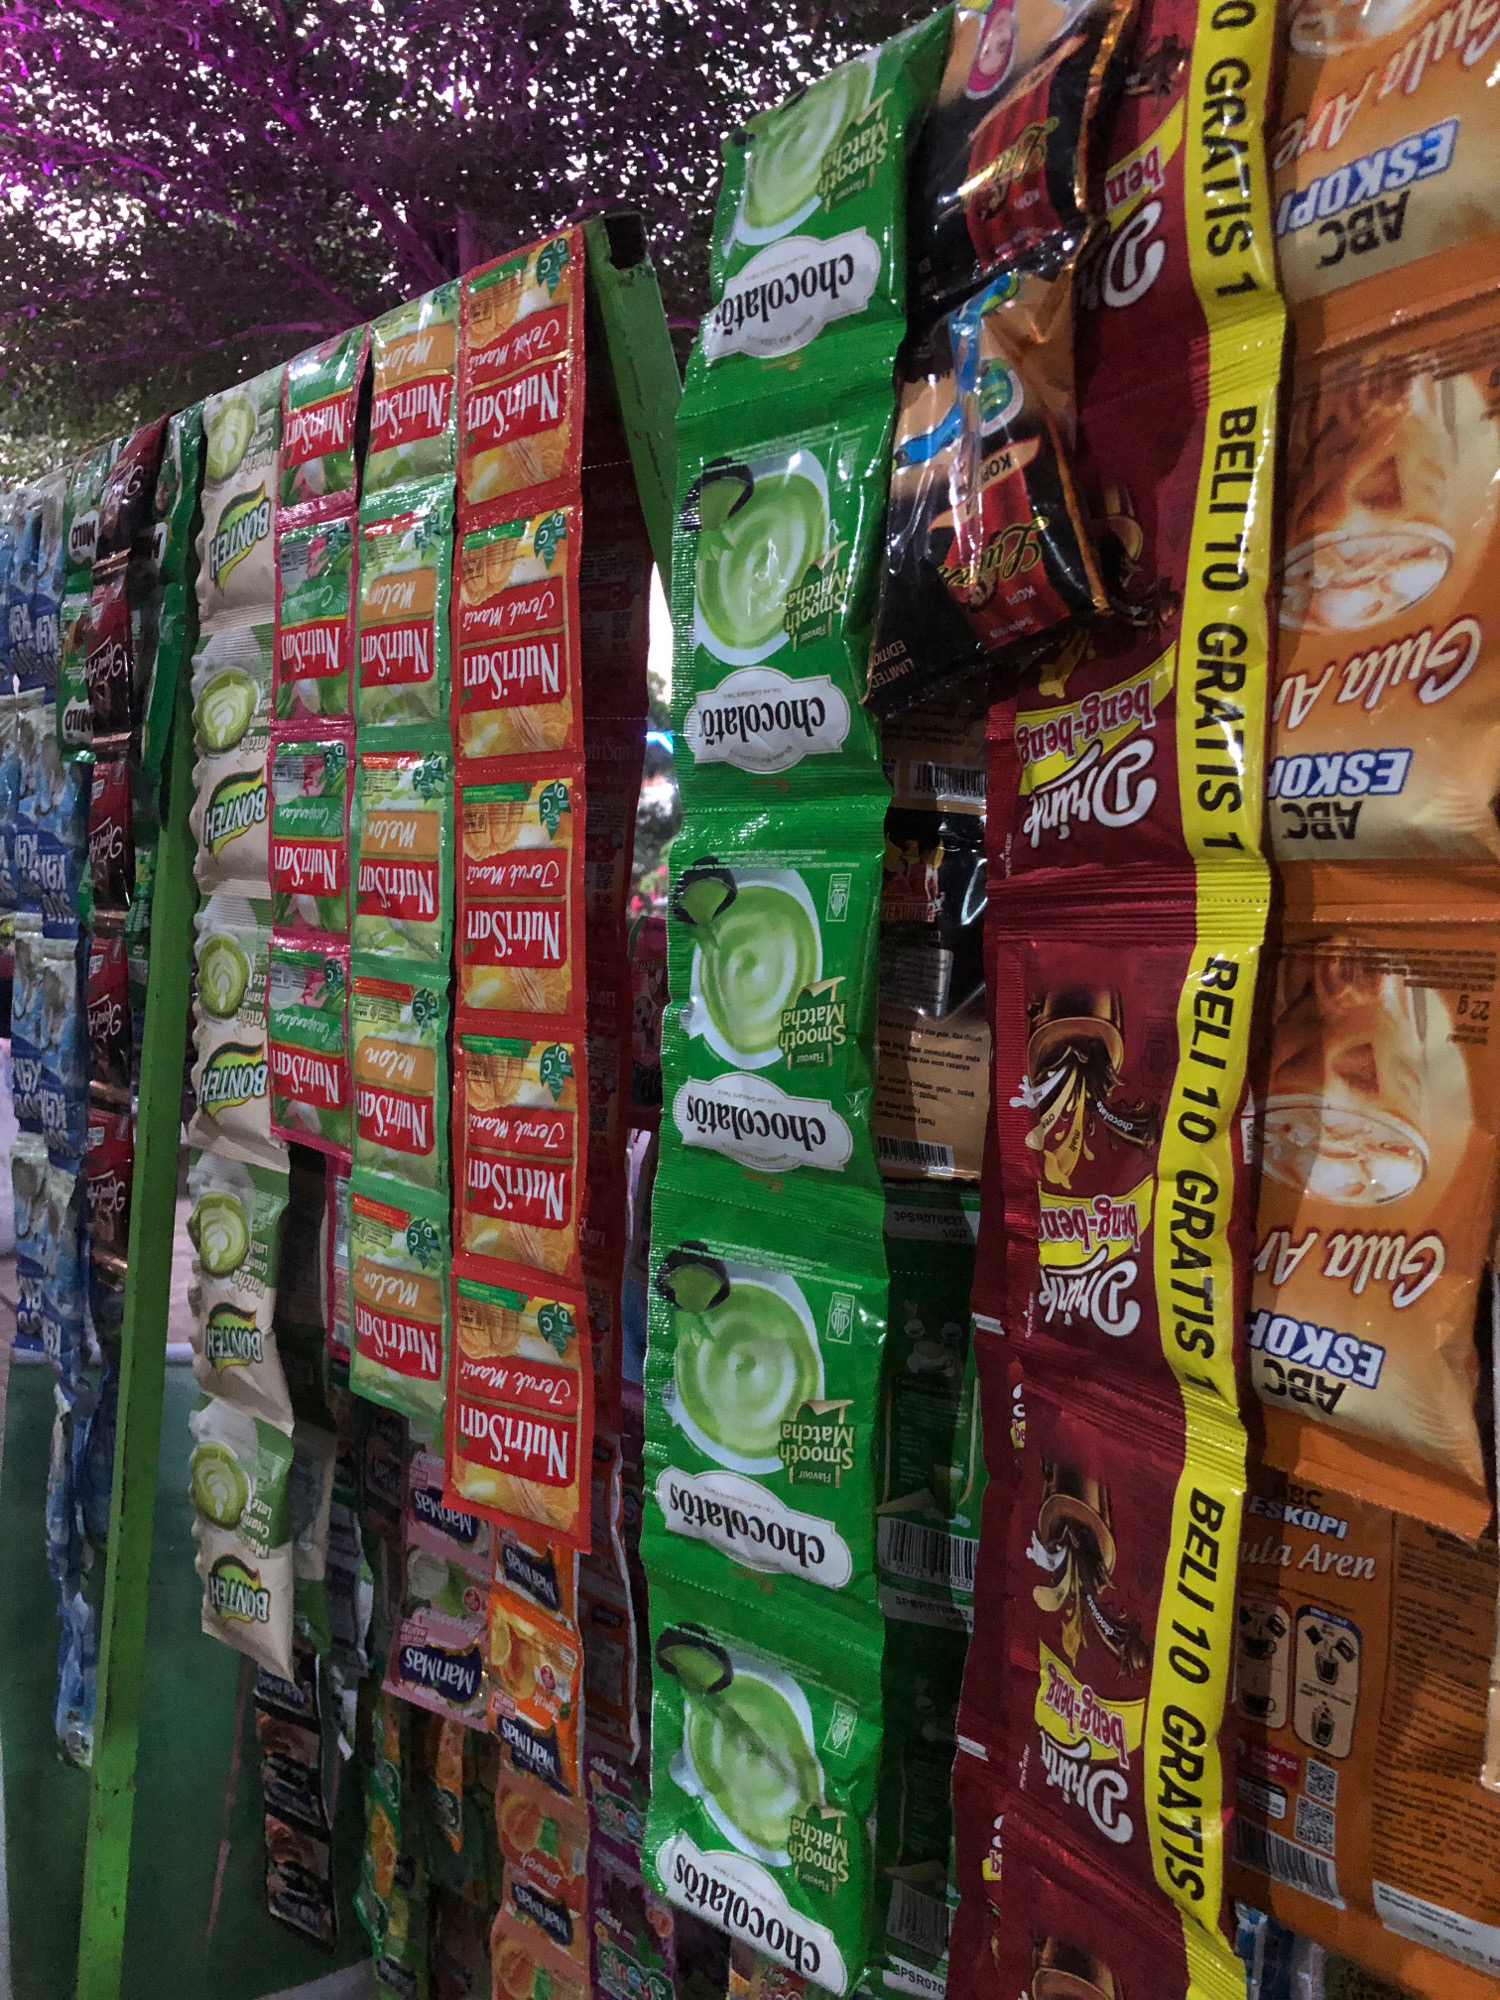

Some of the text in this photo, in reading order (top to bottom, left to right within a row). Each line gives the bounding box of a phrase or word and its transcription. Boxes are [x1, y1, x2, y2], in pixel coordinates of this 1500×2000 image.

[1273, 71, 1375, 171] Are
[821, 117, 889, 174] Matcha
[1202, 58, 1252, 260] GRATIS
[818, 145, 888, 194] Smooth
[1315, 190, 1411, 270] ABC
[1216, 271, 1257, 299] 1
[466, 369, 560, 438] NutriSari
[61, 520, 86, 550] MILO
[209, 500, 270, 577] BONTEH
[461, 590, 555, 632] Jeruk Manis
[786, 568, 848, 611] Matcha
[1006, 585, 1036, 605] KOPI
[785, 591, 846, 634] Smooth
[1194, 404, 1257, 853] BELI 10 GRATIS 1
[462, 643, 560, 700] NutriSari
[871, 640, 906, 664] EDITIO
[871, 659, 914, 687] LIMITED
[1341, 615, 1482, 709] Gula
[65, 708, 92, 733] MILO
[1015, 679, 1156, 766] beng-beng
[204, 786, 267, 837] BONTEH
[1022, 738, 1157, 849] Drink
[1281, 799, 1363, 841] ABC
[461, 861, 559, 889] Jeruk Manis
[467, 910, 560, 959] NutriSari
[782, 1002, 847, 1030] Matcha
[1188, 957, 1239, 1070] BELI
[1474, 999, 1491, 1019] 22
[778, 1025, 846, 1052] Smooth
[796, 1053, 824, 1064] Flavour
[200, 1063, 267, 1107] BONTEH
[364, 1047, 417, 1080] Melon
[468, 1114, 566, 1148] Jeruk Manis
[1041, 1113, 1056, 1130] crea
[1095, 1100, 1134, 1133] chocolate
[1176, 1086, 1220, 1145] 10
[1068, 1129, 1081, 1153] malt
[467, 1157, 566, 1221] NutriSari
[1170, 1169, 1220, 1361] GRATIS
[1322, 1232, 1445, 1309] Gula
[363, 1270, 419, 1309] Melon
[1038, 1243, 1141, 1338] Drink
[206, 1326, 262, 1363] BONTEH
[460, 1359, 570, 1405] Jeruk Manis
[1263, 1358, 1347, 1416] ABC
[460, 1403, 568, 1480] NutriSari
[780, 1423, 854, 1449] Matcha
[780, 1443, 854, 1469] Smooth
[799, 1469, 832, 1483] Flavour
[1248, 1495, 1349, 1540] ESKOPI
[1241, 1536, 1376, 1581] ula Aren
[208, 1577, 268, 1620] BONTEH
[1086, 1593, 1115, 1637] chocolate
[405, 1647, 475, 1695] MariMas
[1042, 1662, 1130, 1771] beng-beng
[1155, 1487, 1226, 1902] BELI 10 GRATIS
[500, 1717, 555, 1778] MariMas
[790, 1817, 848, 1858] Matcha
[788, 1841, 849, 1882] Smooth
